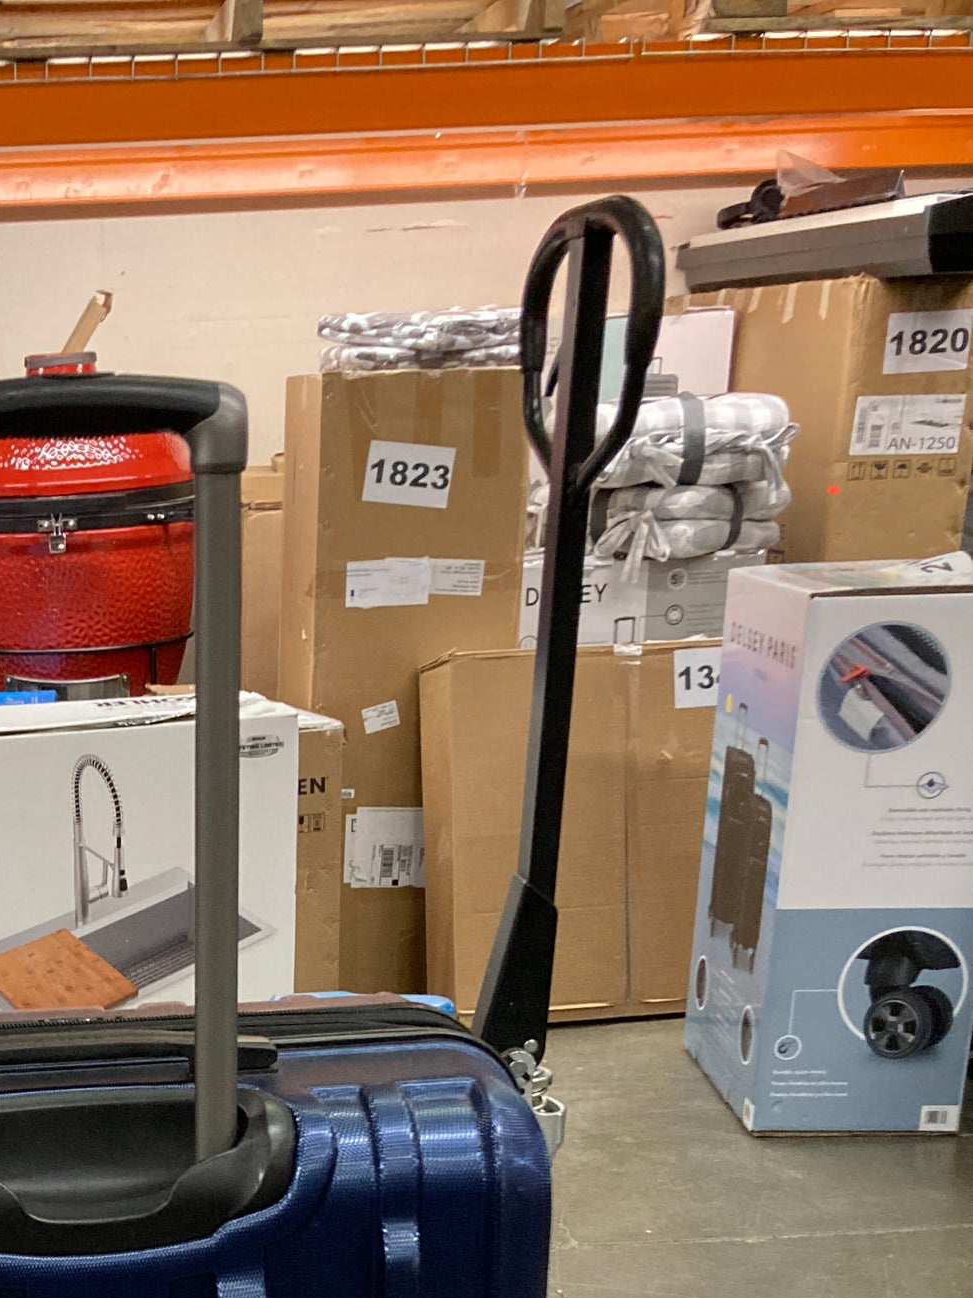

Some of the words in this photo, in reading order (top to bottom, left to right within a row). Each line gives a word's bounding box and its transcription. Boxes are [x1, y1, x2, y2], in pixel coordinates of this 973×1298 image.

[889, 328, 969, 356] 1820
[888, 436, 956, 450] AN-1250
[369, 458, 450, 491] 1823
[678, 664, 720, 691] 13
